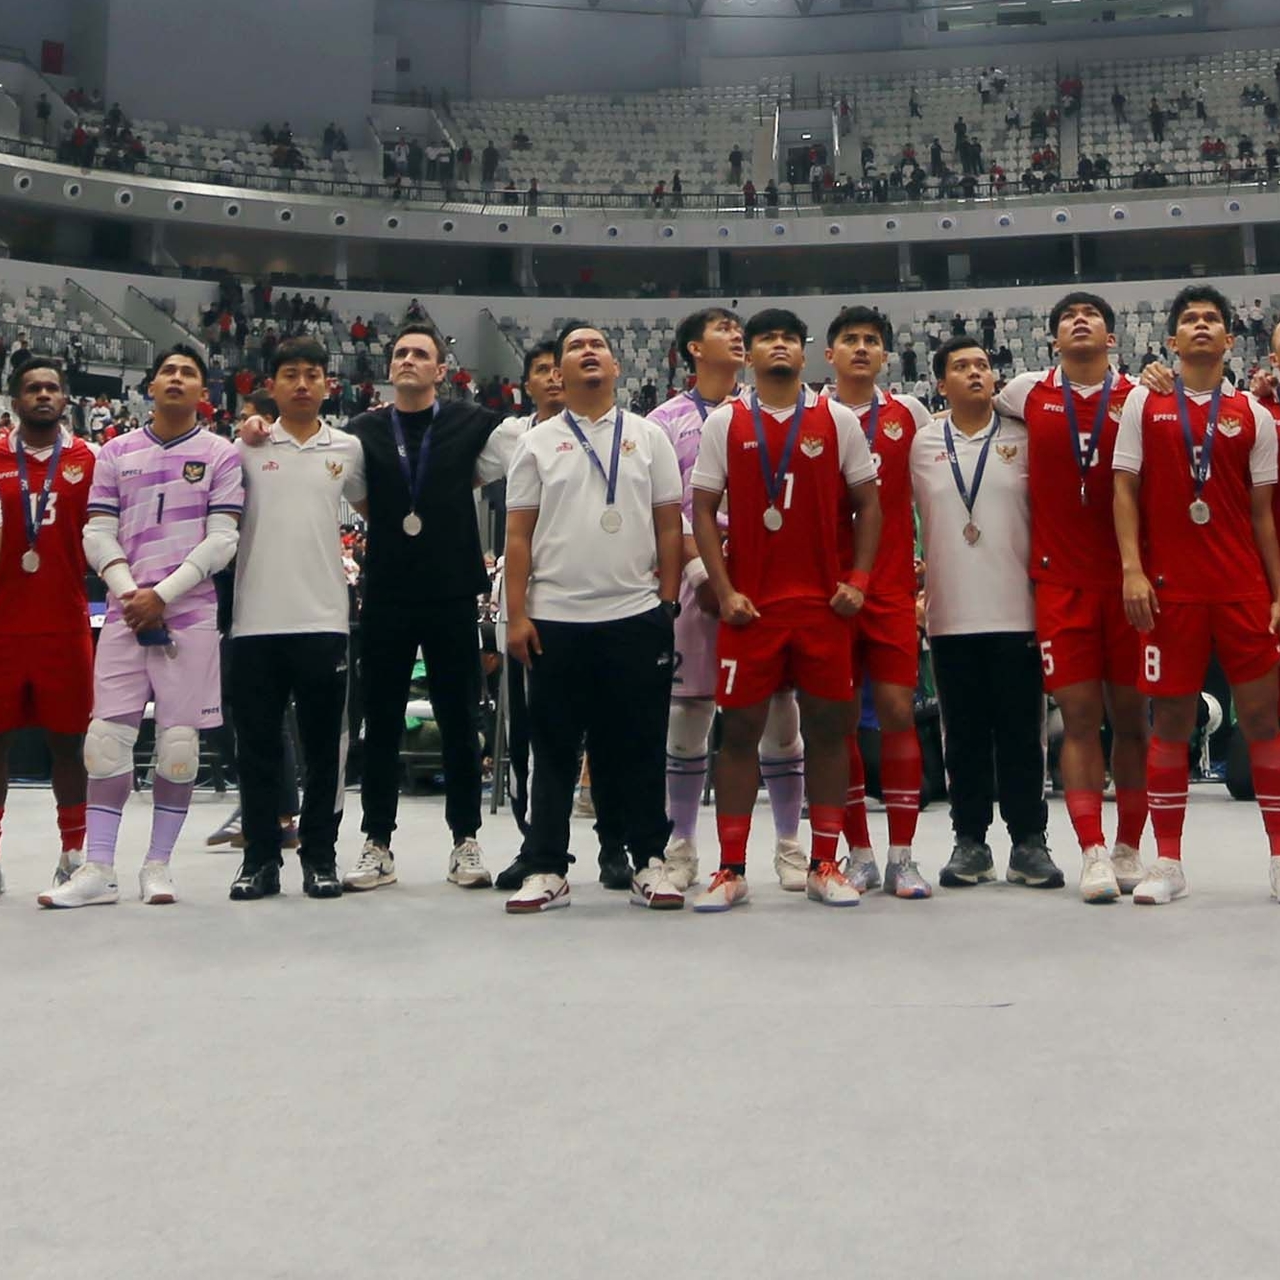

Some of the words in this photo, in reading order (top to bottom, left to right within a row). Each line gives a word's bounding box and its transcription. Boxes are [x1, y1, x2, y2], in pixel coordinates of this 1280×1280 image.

[156, 493, 165, 524] 1
[1040, 640, 1054, 676] 5
[1145, 645, 1161, 682] 8
[721, 658, 738, 695] 7
